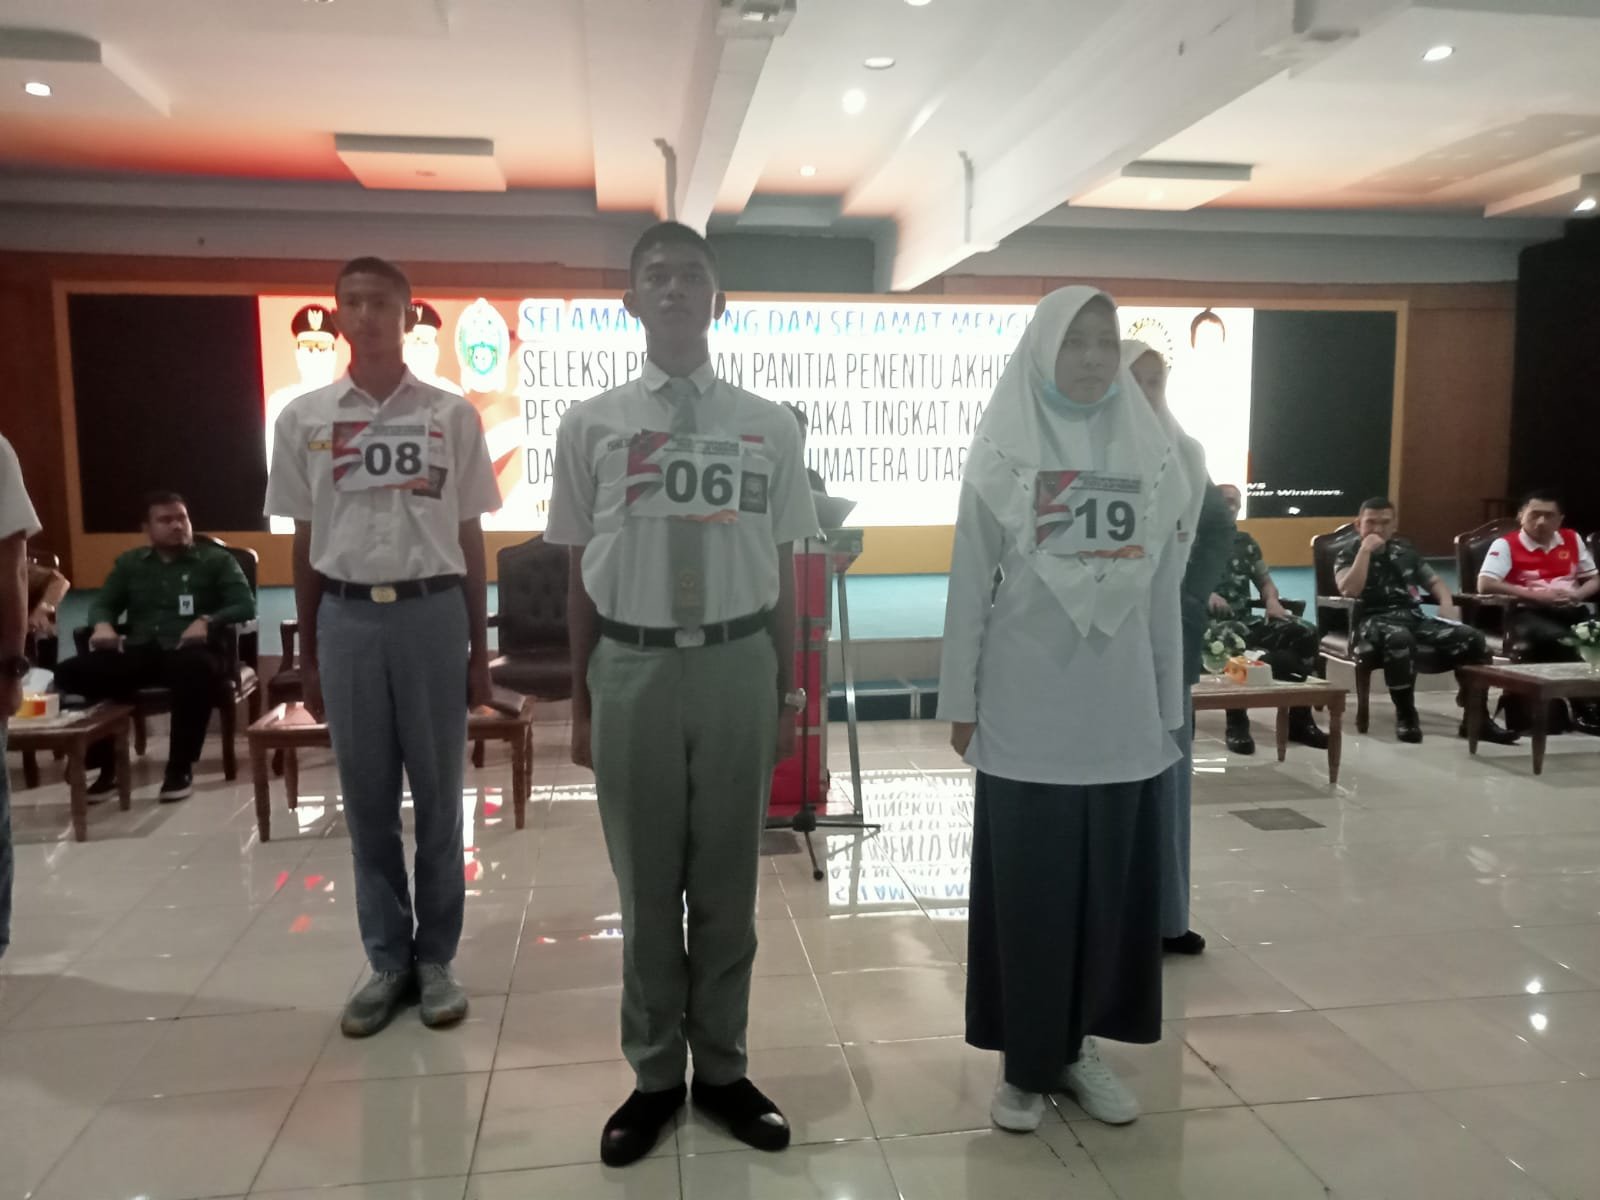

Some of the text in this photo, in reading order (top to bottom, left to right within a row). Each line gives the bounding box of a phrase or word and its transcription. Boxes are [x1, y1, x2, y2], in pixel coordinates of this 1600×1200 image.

[522, 350, 616, 388] SELEKSI
[752, 353, 837, 390] PANITIA
[846, 353, 943, 390] PENENTU
[863, 400, 950, 436] TINGKAT
[365, 442, 421, 476] 08
[527, 448, 554, 485] DA
[808, 447, 908, 483] UMATERA
[665, 459, 734, 506] 06
[1075, 498, 1136, 542] 19
